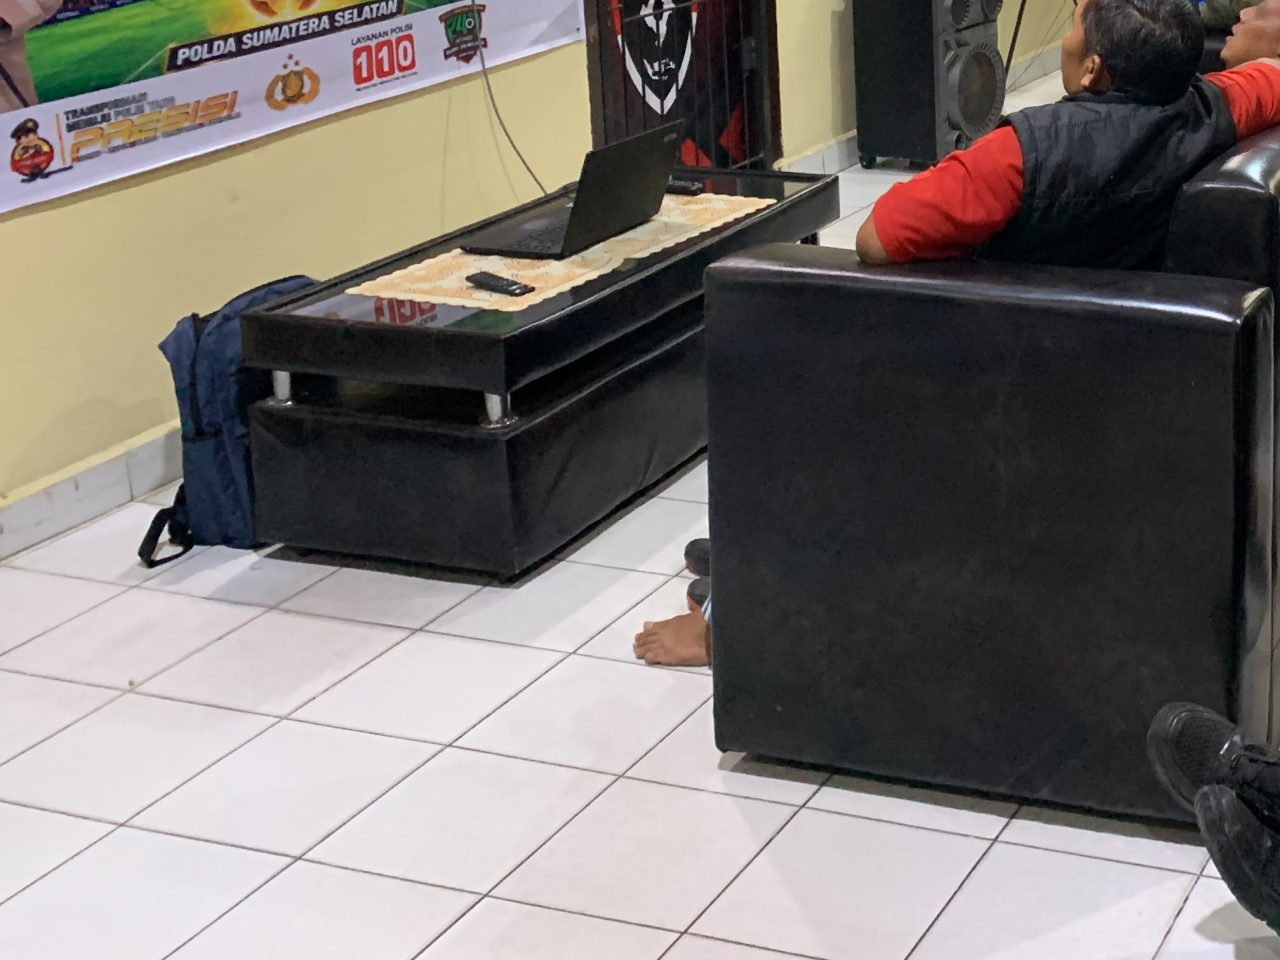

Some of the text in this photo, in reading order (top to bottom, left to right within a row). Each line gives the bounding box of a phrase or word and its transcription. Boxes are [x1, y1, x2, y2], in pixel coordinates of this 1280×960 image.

[177, 37, 236, 66] POLDA
[241, 15, 330, 50] SUMATERA
[351, 23, 413, 46] LAYANAN POLISI
[354, 37, 415, 83] 110
[71, 90, 239, 161] PRESISI
